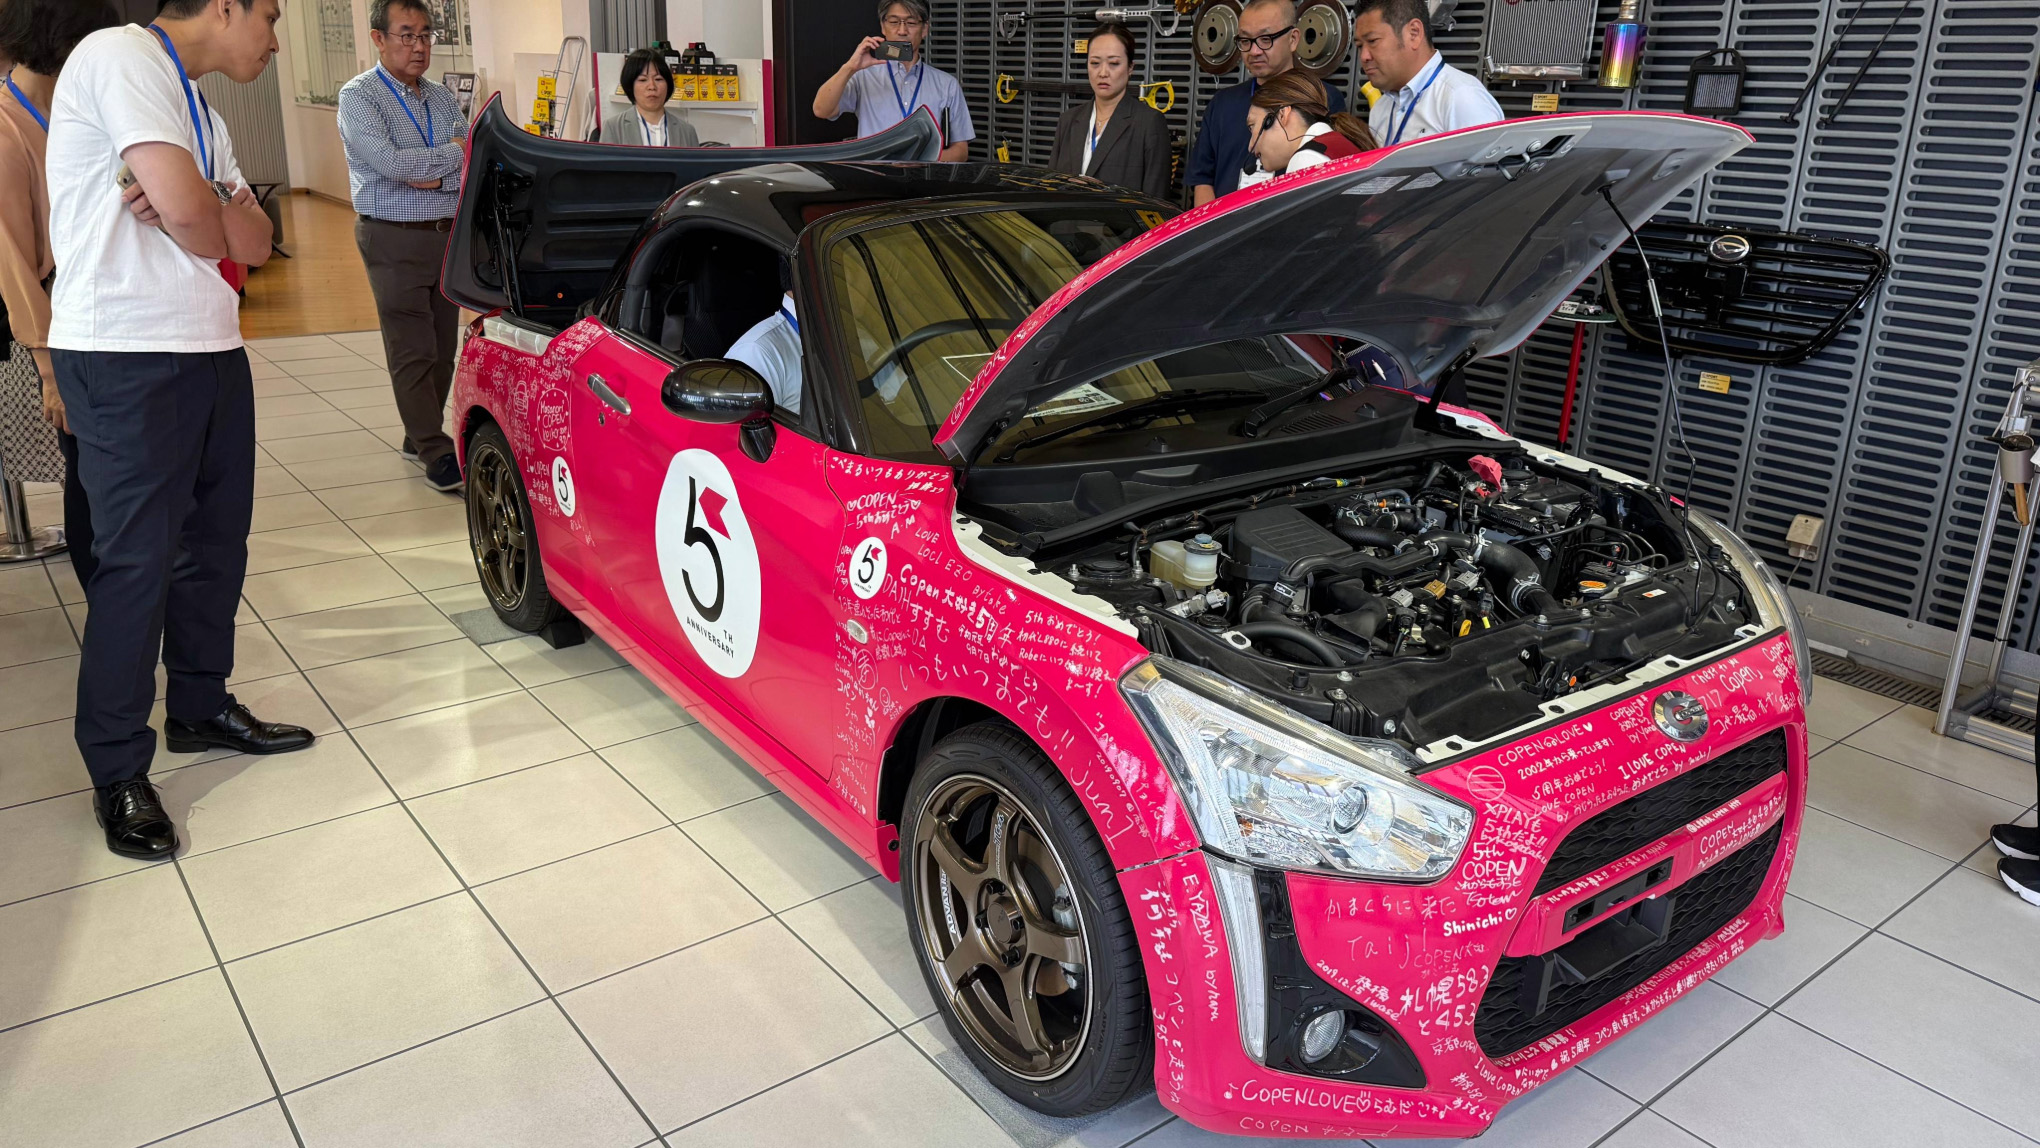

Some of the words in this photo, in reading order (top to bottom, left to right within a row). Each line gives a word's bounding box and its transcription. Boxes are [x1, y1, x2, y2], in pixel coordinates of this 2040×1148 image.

[856, 490, 899, 510] COPEN
[681, 475, 725, 623] 5
[914, 527, 940, 545] LOVE
[857, 543, 876, 584] 5
[686, 616, 735, 659] ANNIVERSARY
[723, 629, 734, 644] TH
[1497, 740, 1546, 768] COPEN
[1554, 723, 1584, 745] LOVE
[1626, 752, 1655, 776] LOVE
[1653, 743, 1687, 761] COPEN
[1563, 782, 1596, 804] COPEN
[1472, 842, 1505, 861] 5th
[1700, 820, 1734, 855] COPEN
[1461, 856, 1527, 881] COPEN
[940, 886, 957, 934] ADVAN
[1442, 911, 1504, 937] Shinichi
